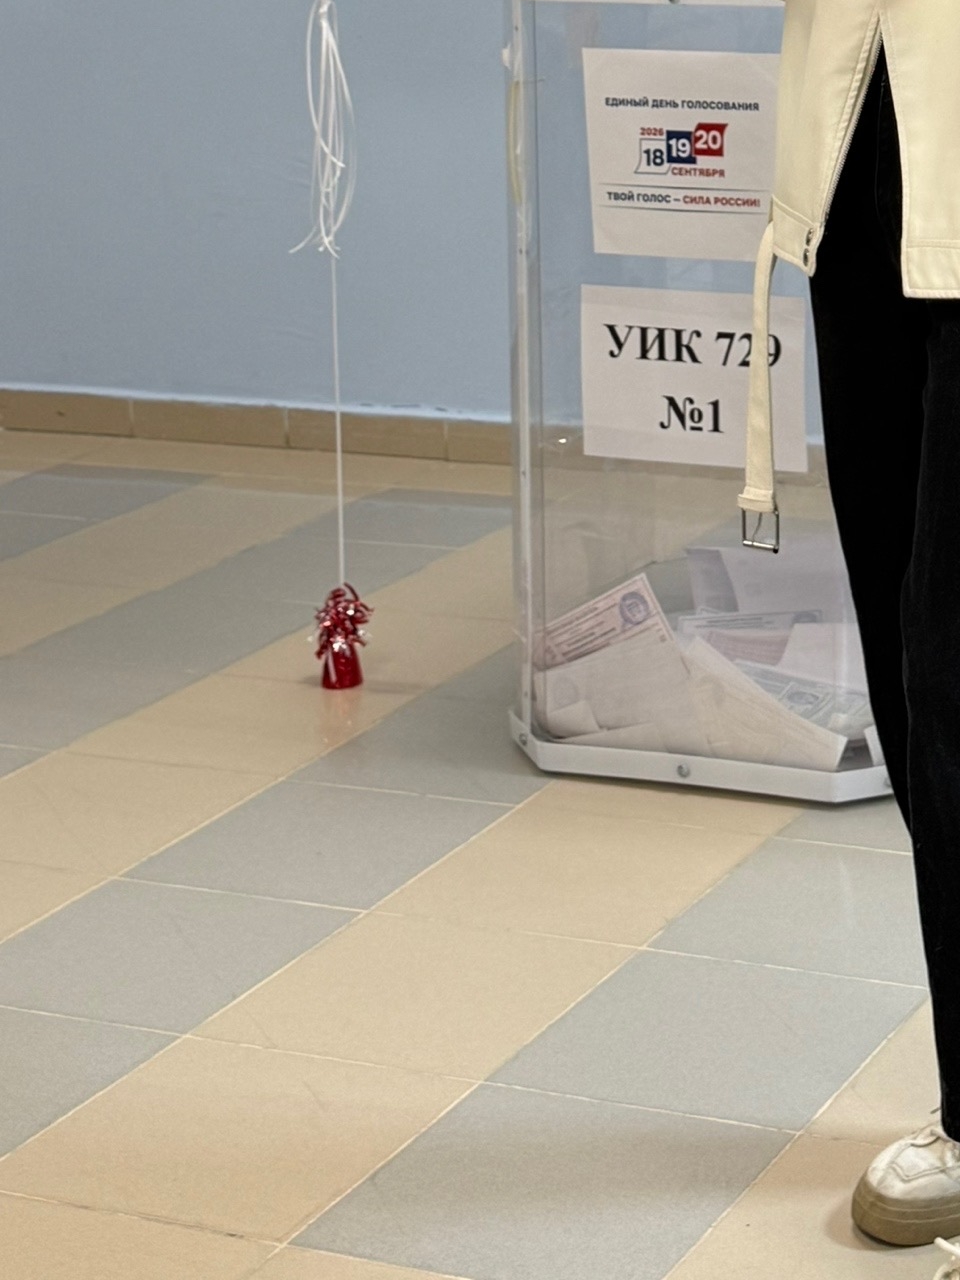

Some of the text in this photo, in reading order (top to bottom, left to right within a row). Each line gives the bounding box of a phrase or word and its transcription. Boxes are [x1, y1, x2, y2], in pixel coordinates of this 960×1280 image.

[605, 96, 760, 111] ЕДИНЫЙ ДЕНЬ ГОЛОСОВАНИЯ
[639, 126, 665, 137] 2026
[643, 129, 722, 167] 18 19 20
[671, 166, 726, 179] СЕНТЯБРЯ
[606, 191, 636, 202] ТВОЙ
[636, 193, 672, 204] ГОЛОС
[682, 195, 712, 206] СИЛА
[713, 196, 761, 208] РОССИИ!
[603, 323, 782, 368] УИК 729
[659, 394, 725, 434] №1
